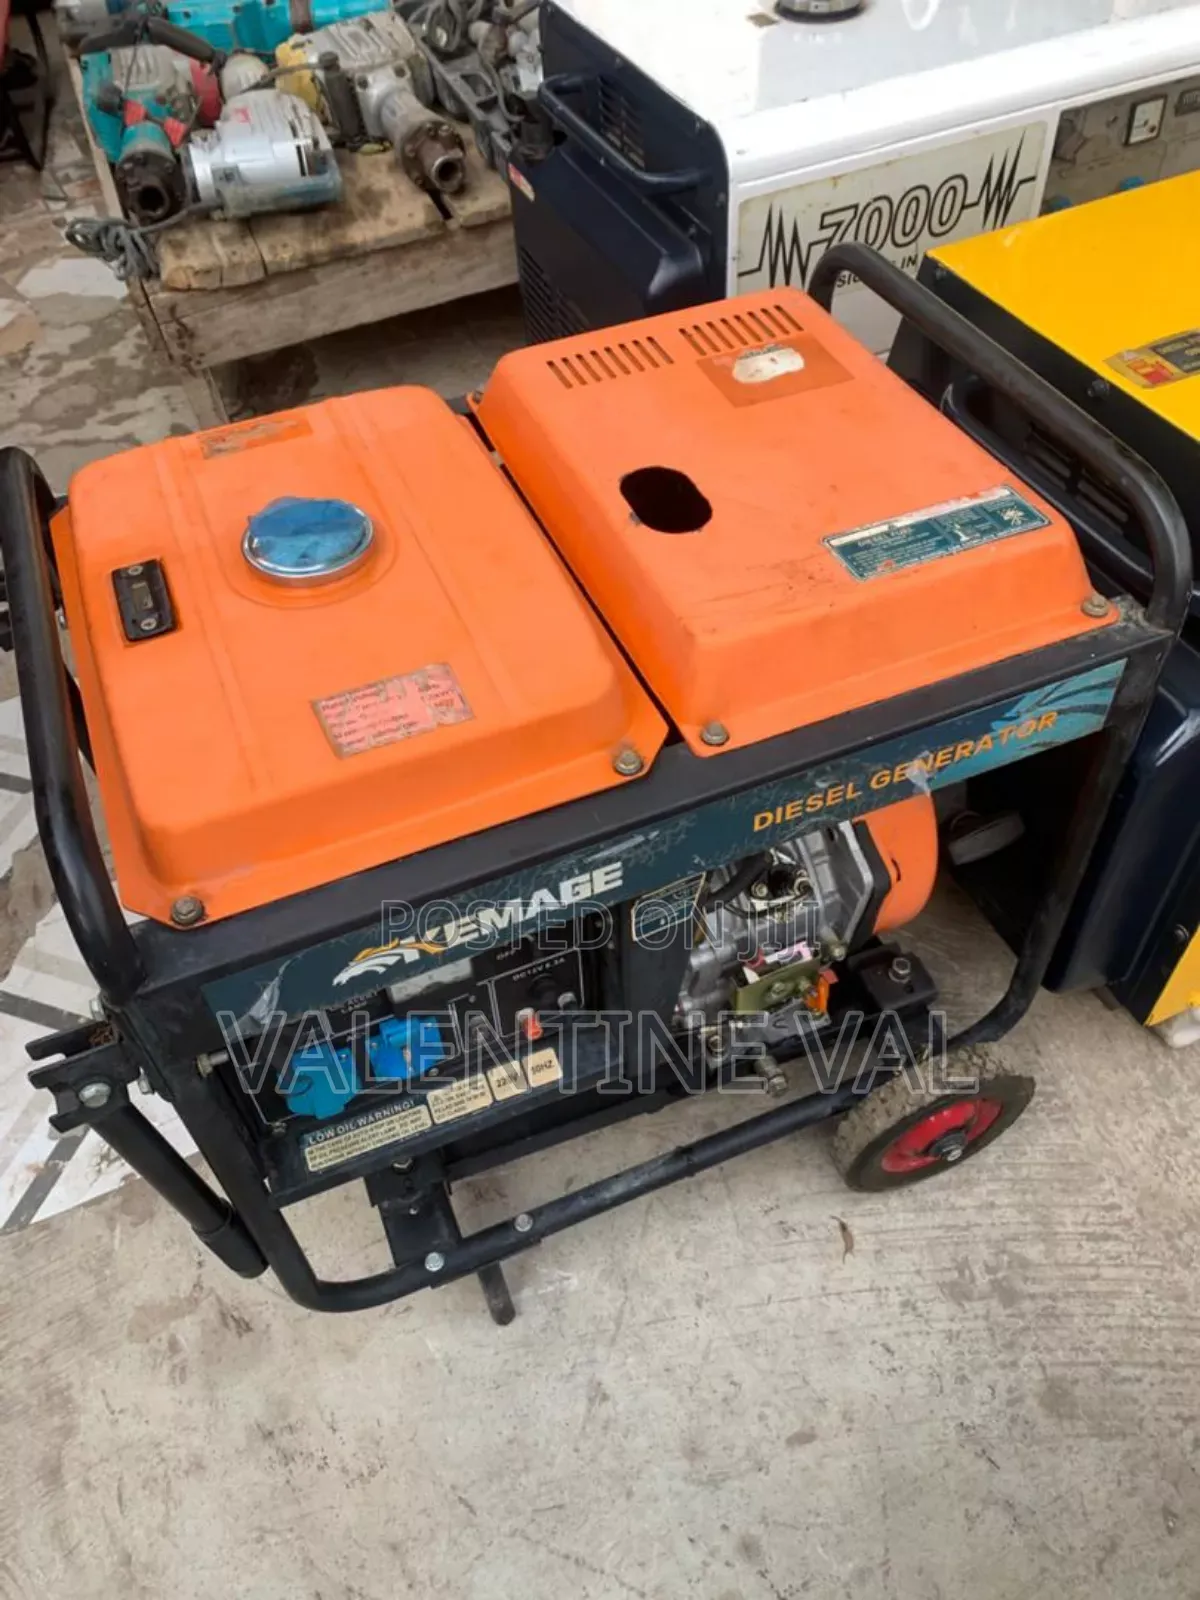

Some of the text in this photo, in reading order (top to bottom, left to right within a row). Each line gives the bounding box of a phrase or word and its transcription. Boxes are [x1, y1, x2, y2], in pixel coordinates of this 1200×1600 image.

[819, 174, 968, 250] 7000
[753, 711, 1058, 832] DIESEL GENERATOR
[309, 1100, 415, 1145] LOW OIL WARNING!
